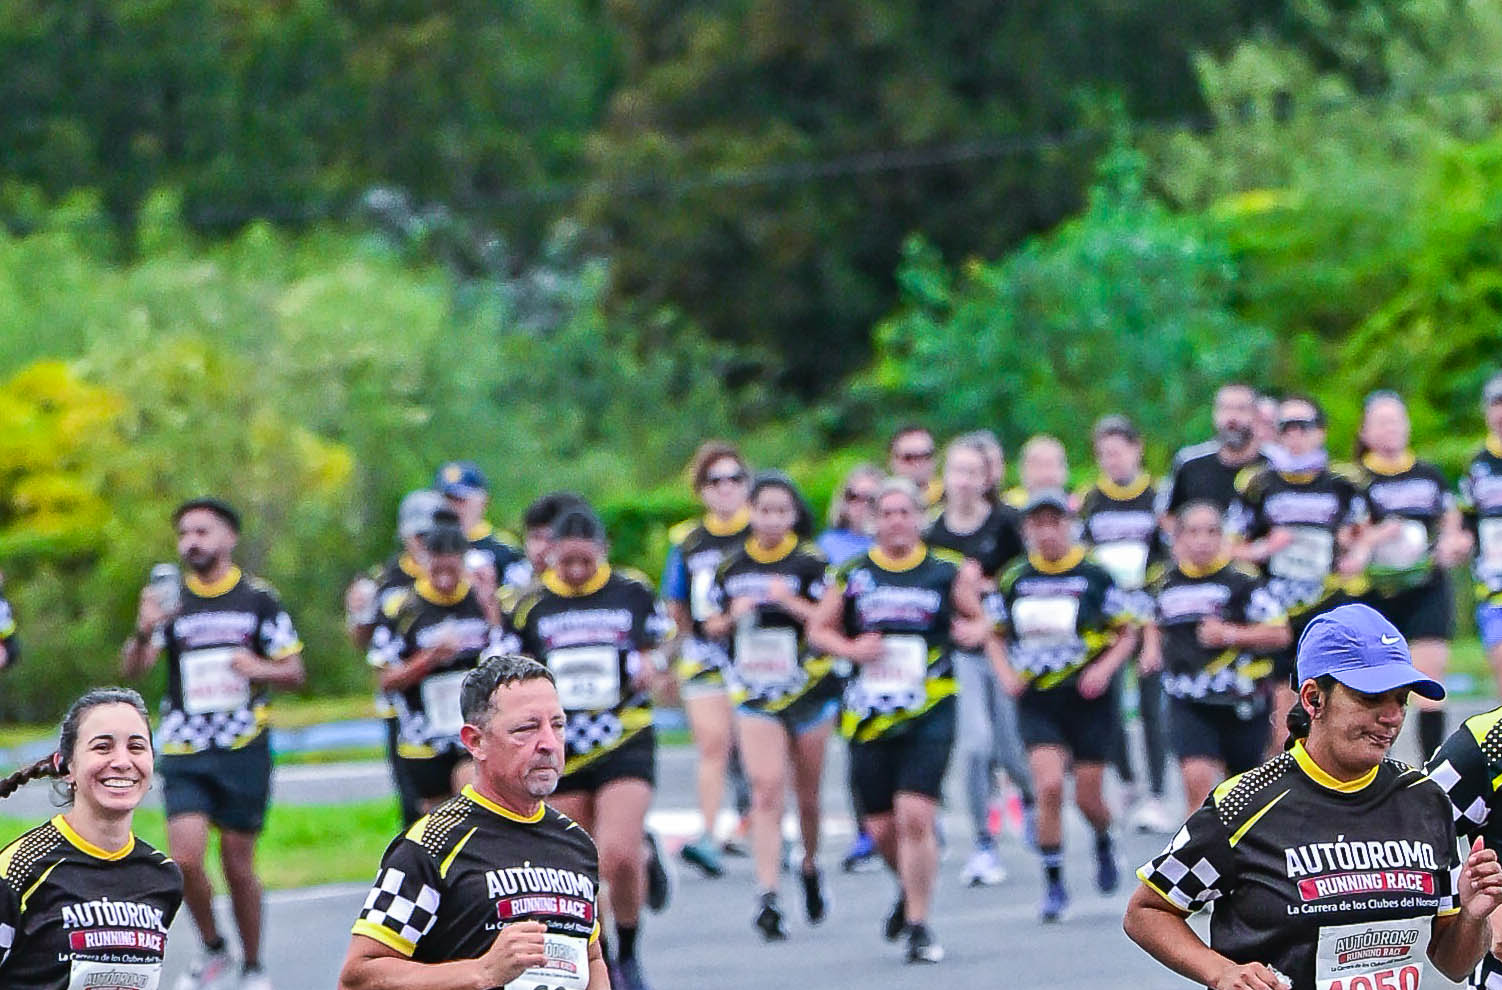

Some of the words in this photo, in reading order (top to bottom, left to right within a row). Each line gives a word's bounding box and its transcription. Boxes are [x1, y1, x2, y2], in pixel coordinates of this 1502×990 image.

[1284, 834, 1439, 878] AUTÓDROMO
[485, 860, 594, 902] AUTÓDROMO
[1314, 874, 1383, 897] RUNNING
[1385, 872, 1424, 891] RACE
[511, 897, 557, 916] RUNNING
[559, 899, 586, 919] RACE
[1287, 905, 1299, 915] La
[1301, 903, 1337, 914] Carrera
[1339, 901, 1351, 911] de
[1353, 899, 1366, 910] los
[1368, 898, 1399, 909] Clubes
[1400, 896, 1415, 907] del
[84, 931, 137, 948] RUNNING
[138, 932, 162, 951] RACE
[1334, 928, 1420, 955] AUTÓDROMO
[1346, 951, 1381, 961] RUNNING
